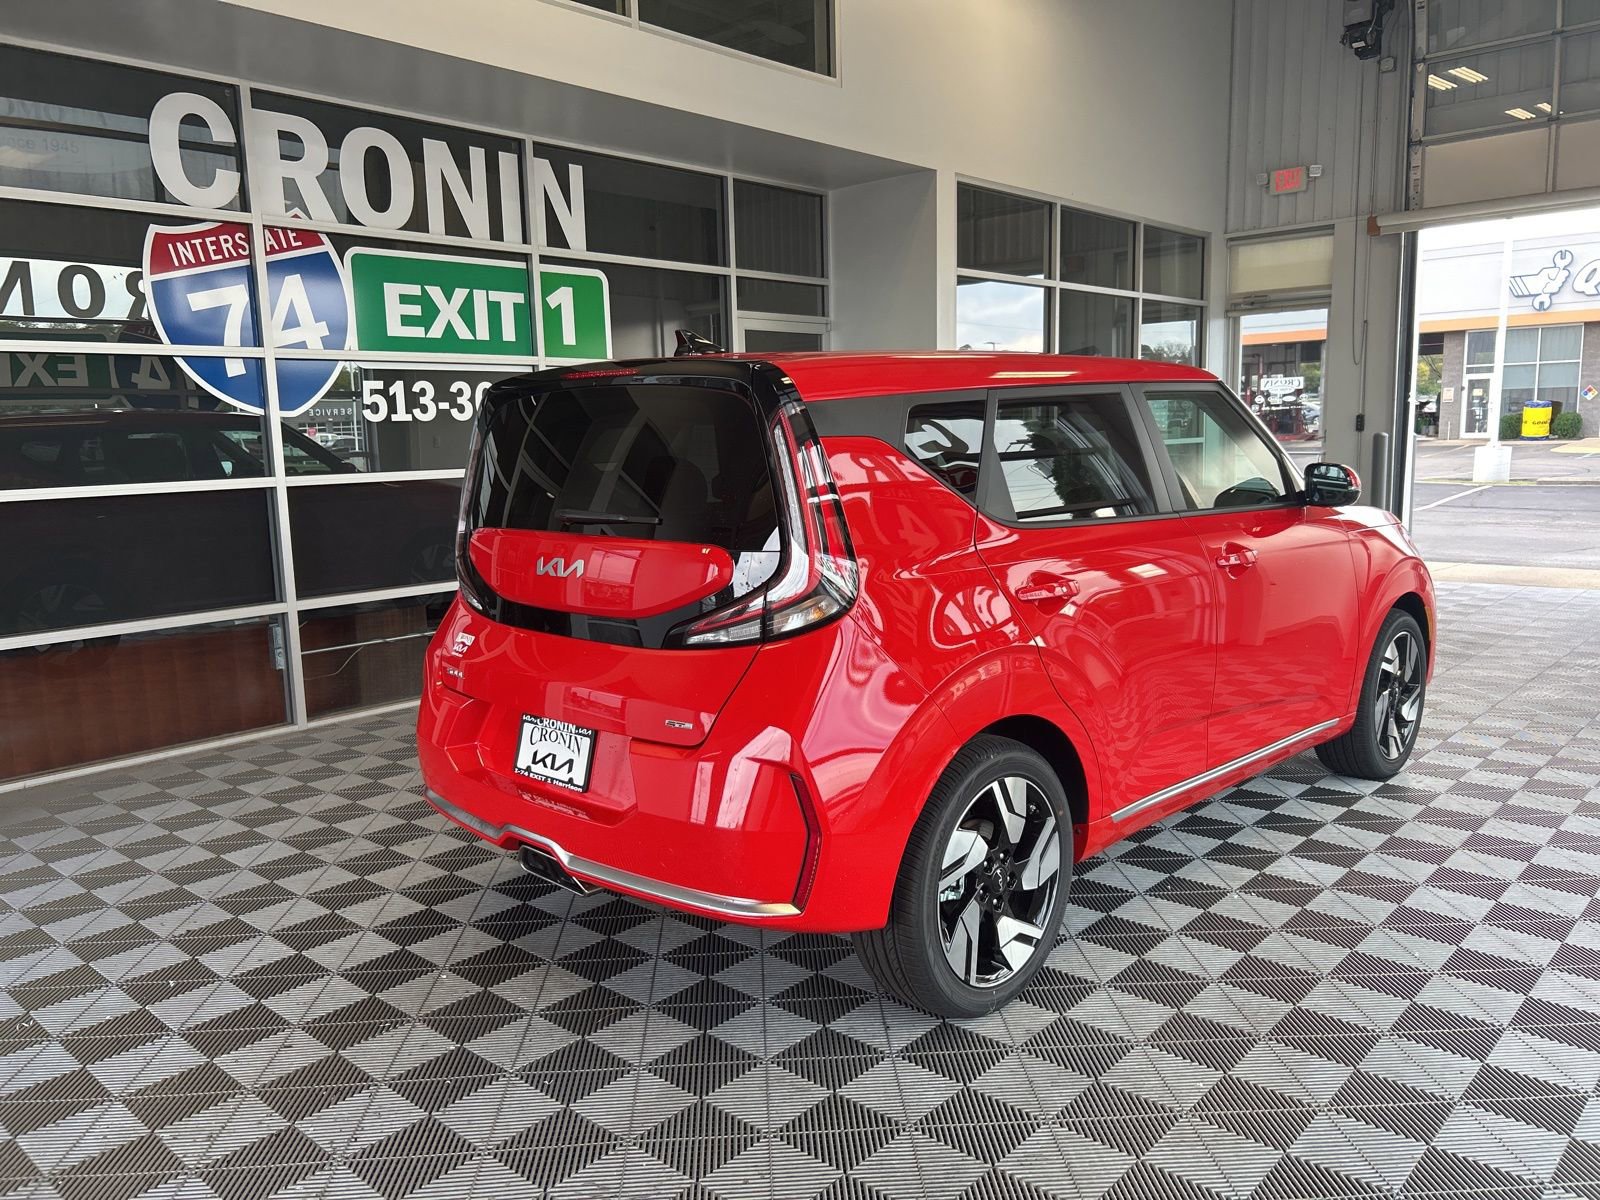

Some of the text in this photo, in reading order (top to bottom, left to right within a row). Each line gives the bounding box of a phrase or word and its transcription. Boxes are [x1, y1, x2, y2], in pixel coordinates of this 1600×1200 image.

[149, 92, 587, 251] CRONIN
[1275, 167, 1302, 193] EXIT
[187, 273, 329, 378] 74
[383, 282, 577, 346] EXIT 1
[536, 556, 585, 579] KIA
[537, 717, 576, 734] CRONIN
[529, 725, 583, 757] CRONIN
[531, 749, 575, 775] KIA
[529, 773, 546, 782] EXIT
[553, 779, 583, 793] Harrison
